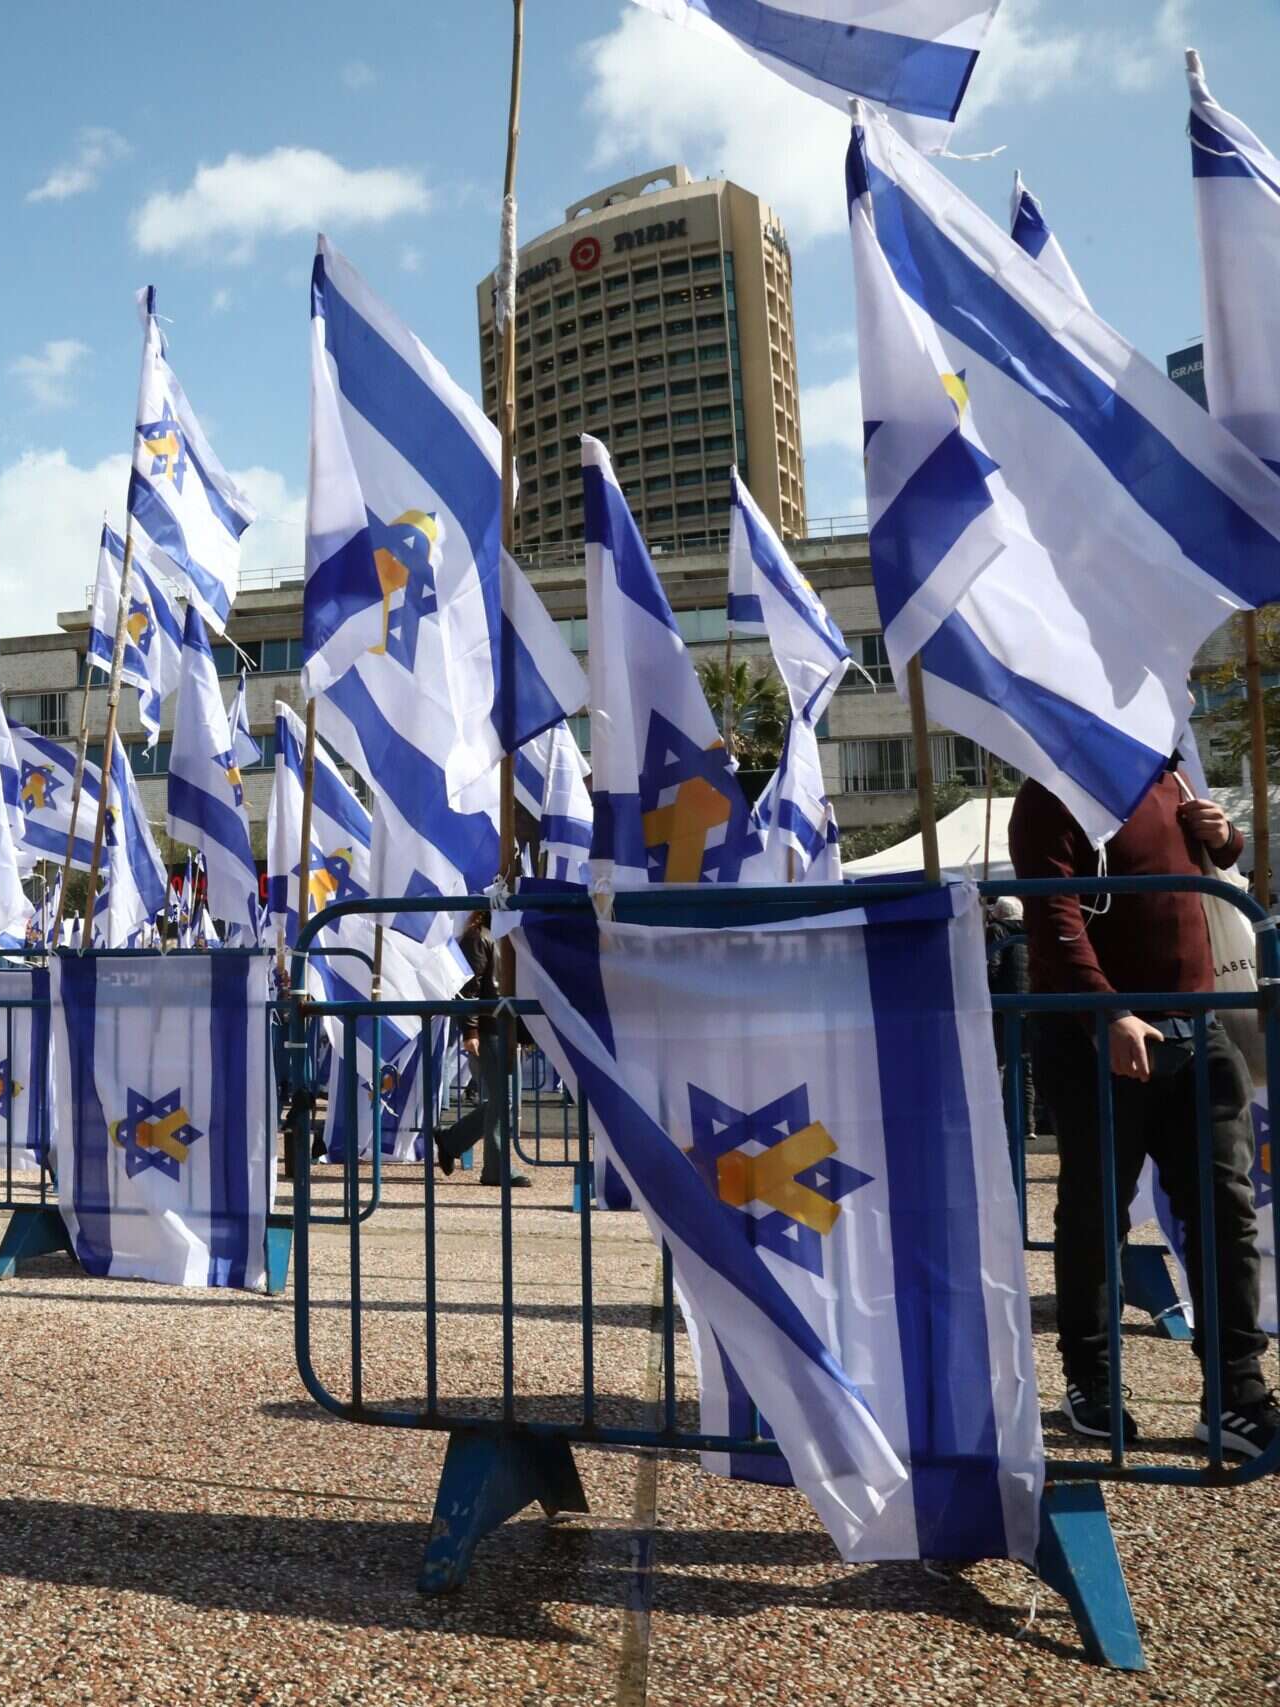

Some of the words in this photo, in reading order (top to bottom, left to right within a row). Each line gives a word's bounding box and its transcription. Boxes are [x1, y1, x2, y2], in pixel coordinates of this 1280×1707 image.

[613, 218, 687, 251] אמות
[1171, 361, 1204, 379] ISRAEL
[1214, 959, 1255, 977] LABEL
